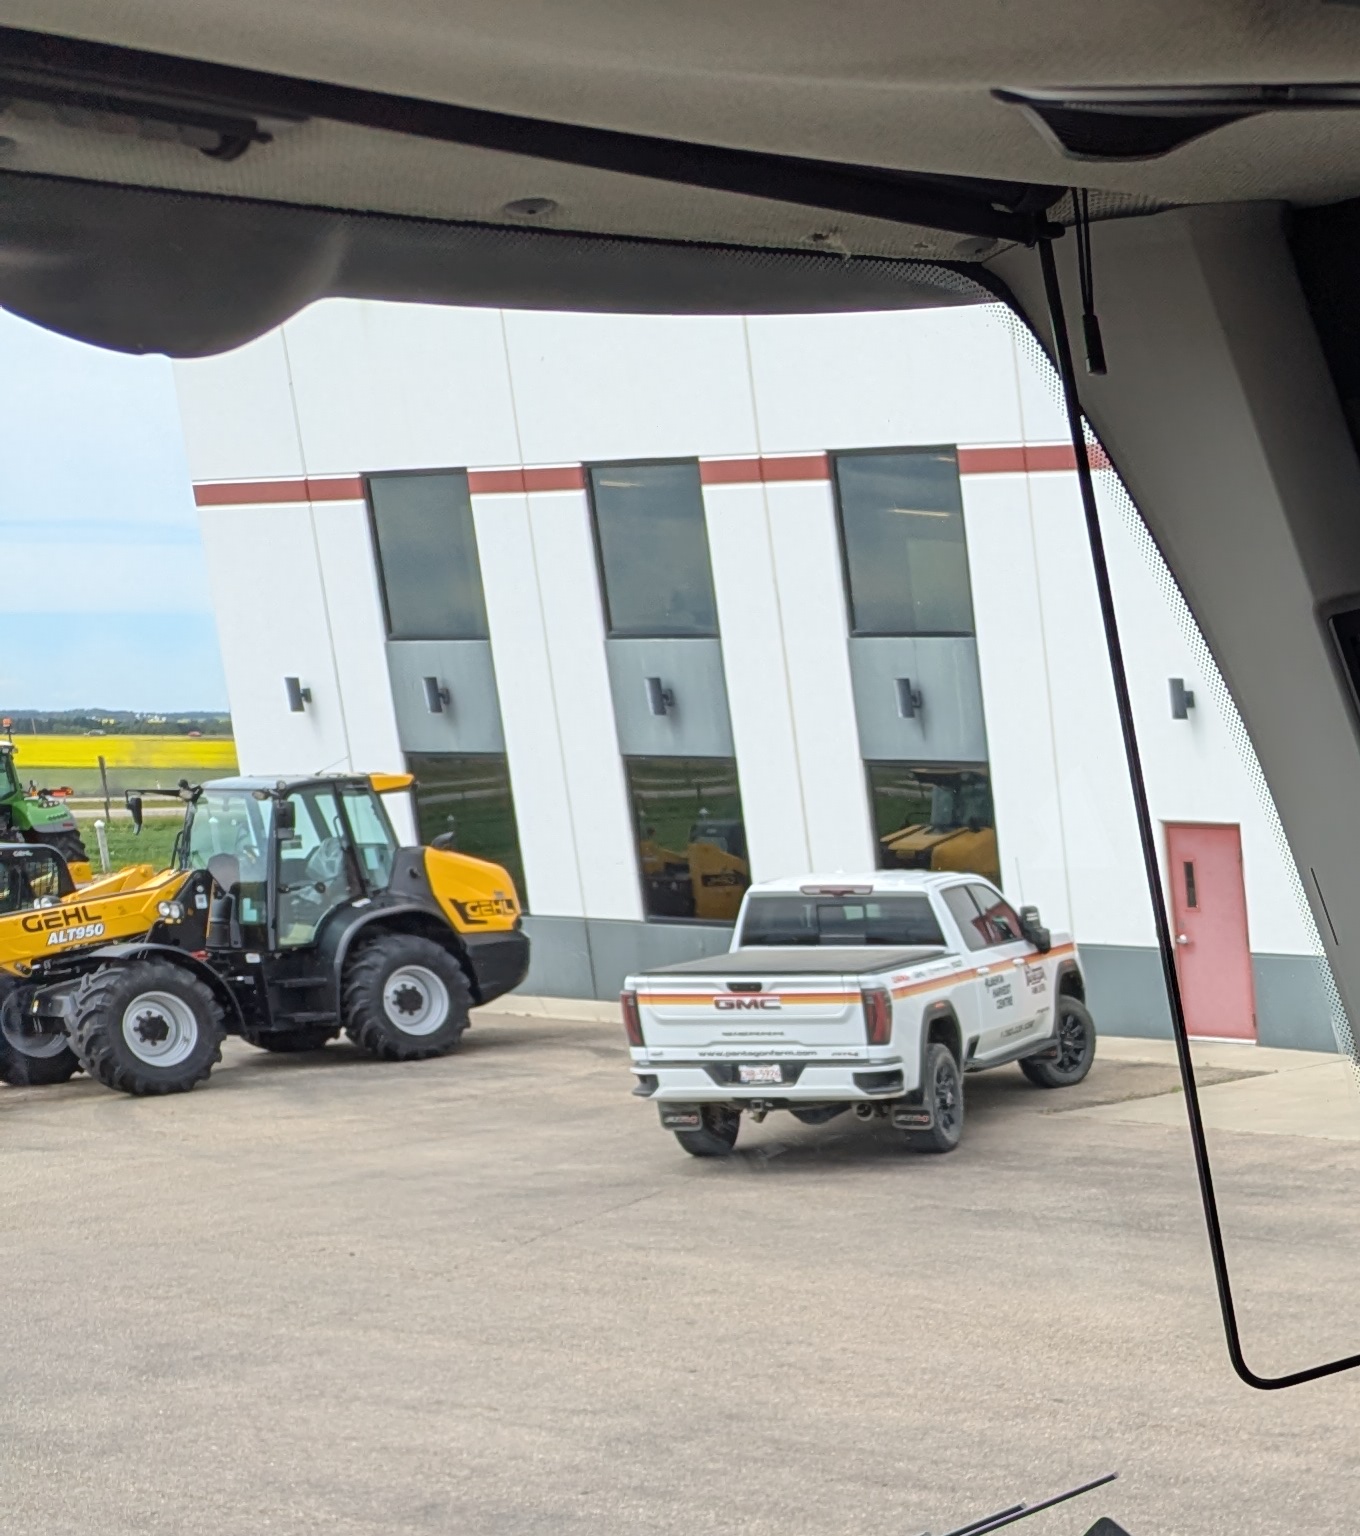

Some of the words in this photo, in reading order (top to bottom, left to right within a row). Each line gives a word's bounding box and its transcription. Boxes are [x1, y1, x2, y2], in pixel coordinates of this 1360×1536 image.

[22, 905, 102, 933] GEHL
[465, 900, 517, 918] GEHL
[47, 923, 104, 945] ALT950
[714, 999, 782, 1010] GMC
